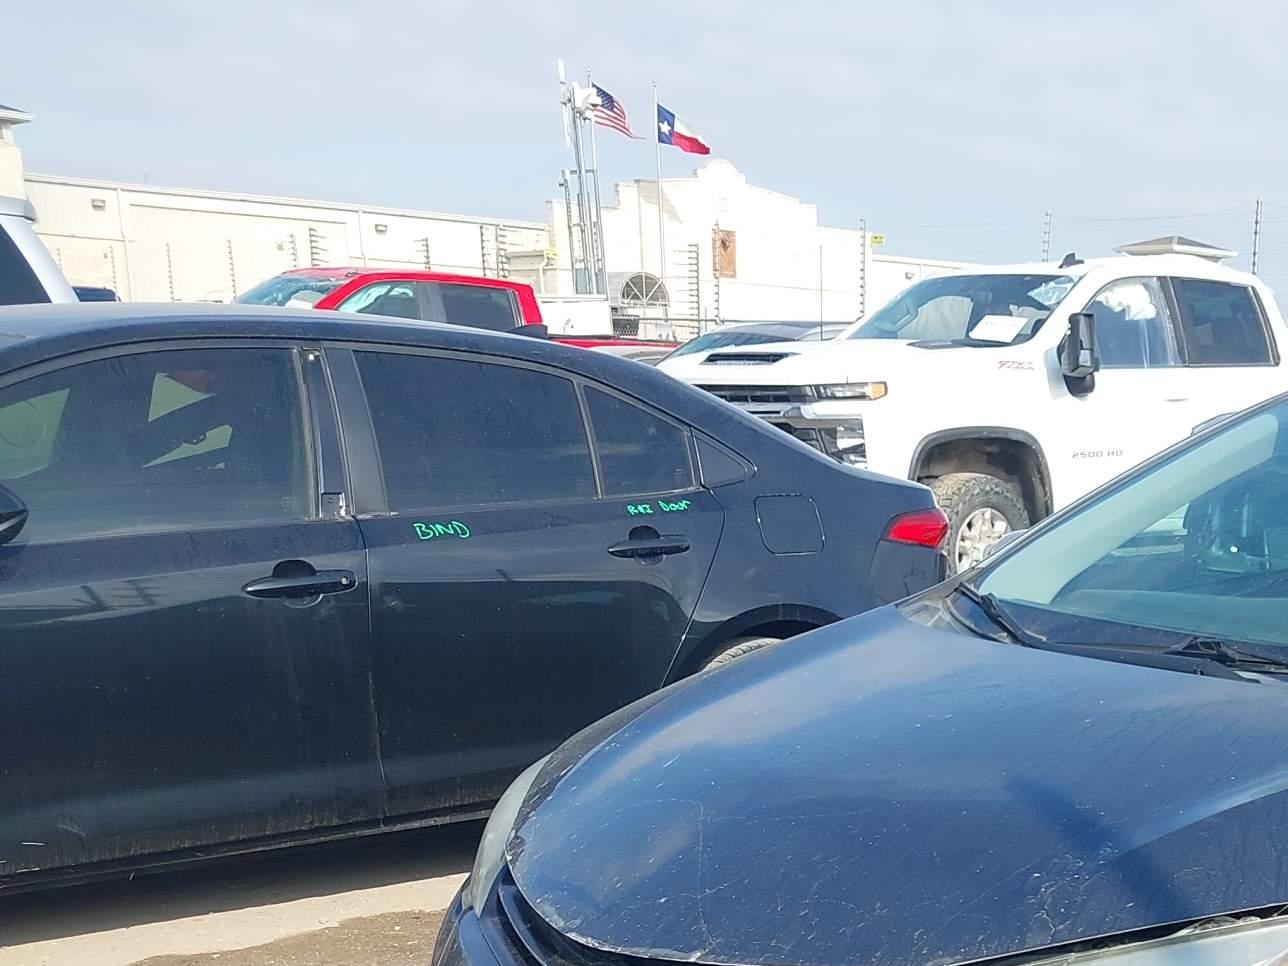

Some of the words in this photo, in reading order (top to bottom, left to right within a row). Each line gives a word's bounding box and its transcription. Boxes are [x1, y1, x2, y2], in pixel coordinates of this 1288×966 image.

[1071, 450, 1104, 459] 2500
[1107, 449, 1124, 458] HD
[412, 520, 470, 540] BIND
